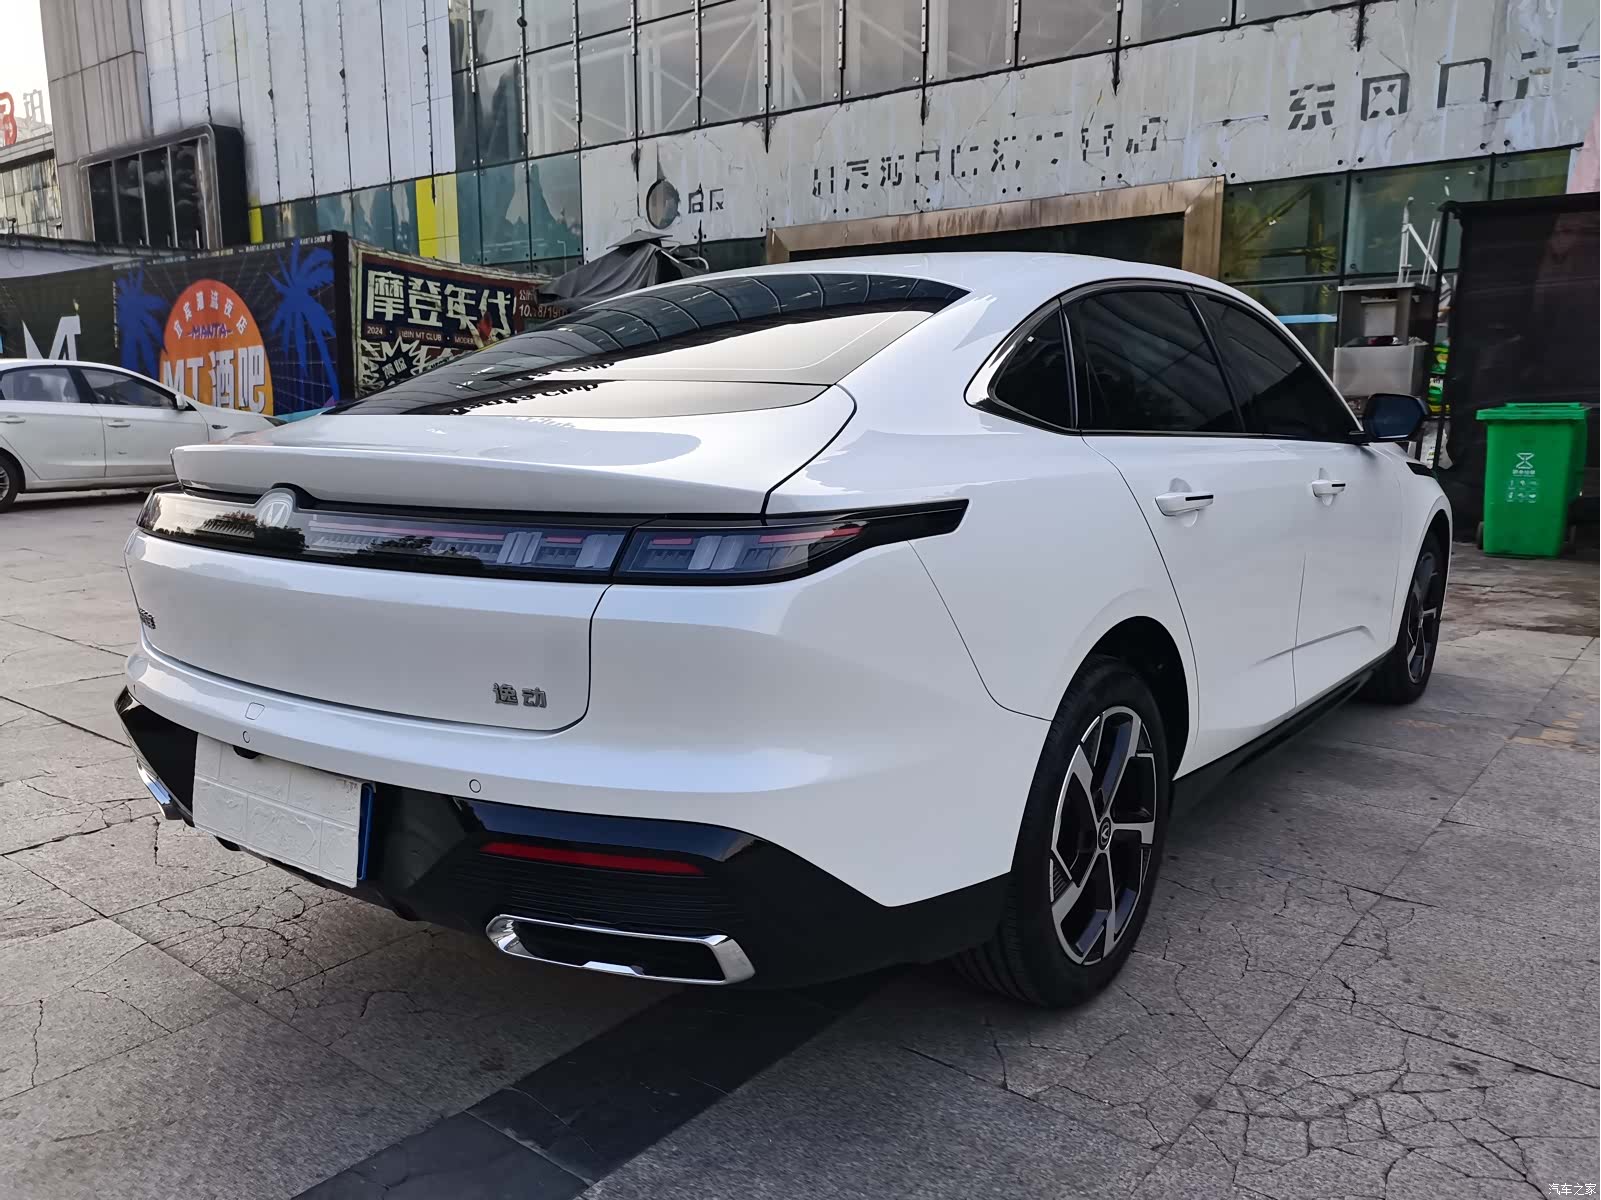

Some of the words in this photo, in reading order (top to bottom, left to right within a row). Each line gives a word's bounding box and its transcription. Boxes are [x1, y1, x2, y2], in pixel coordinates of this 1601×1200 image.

[366, 270, 511, 345] 摩登年代
[367, 326, 384, 335] 2024
[416, 331, 425, 339] MT
[426, 332, 442, 341] CLUB
[492, 682, 548, 708] 逸动
